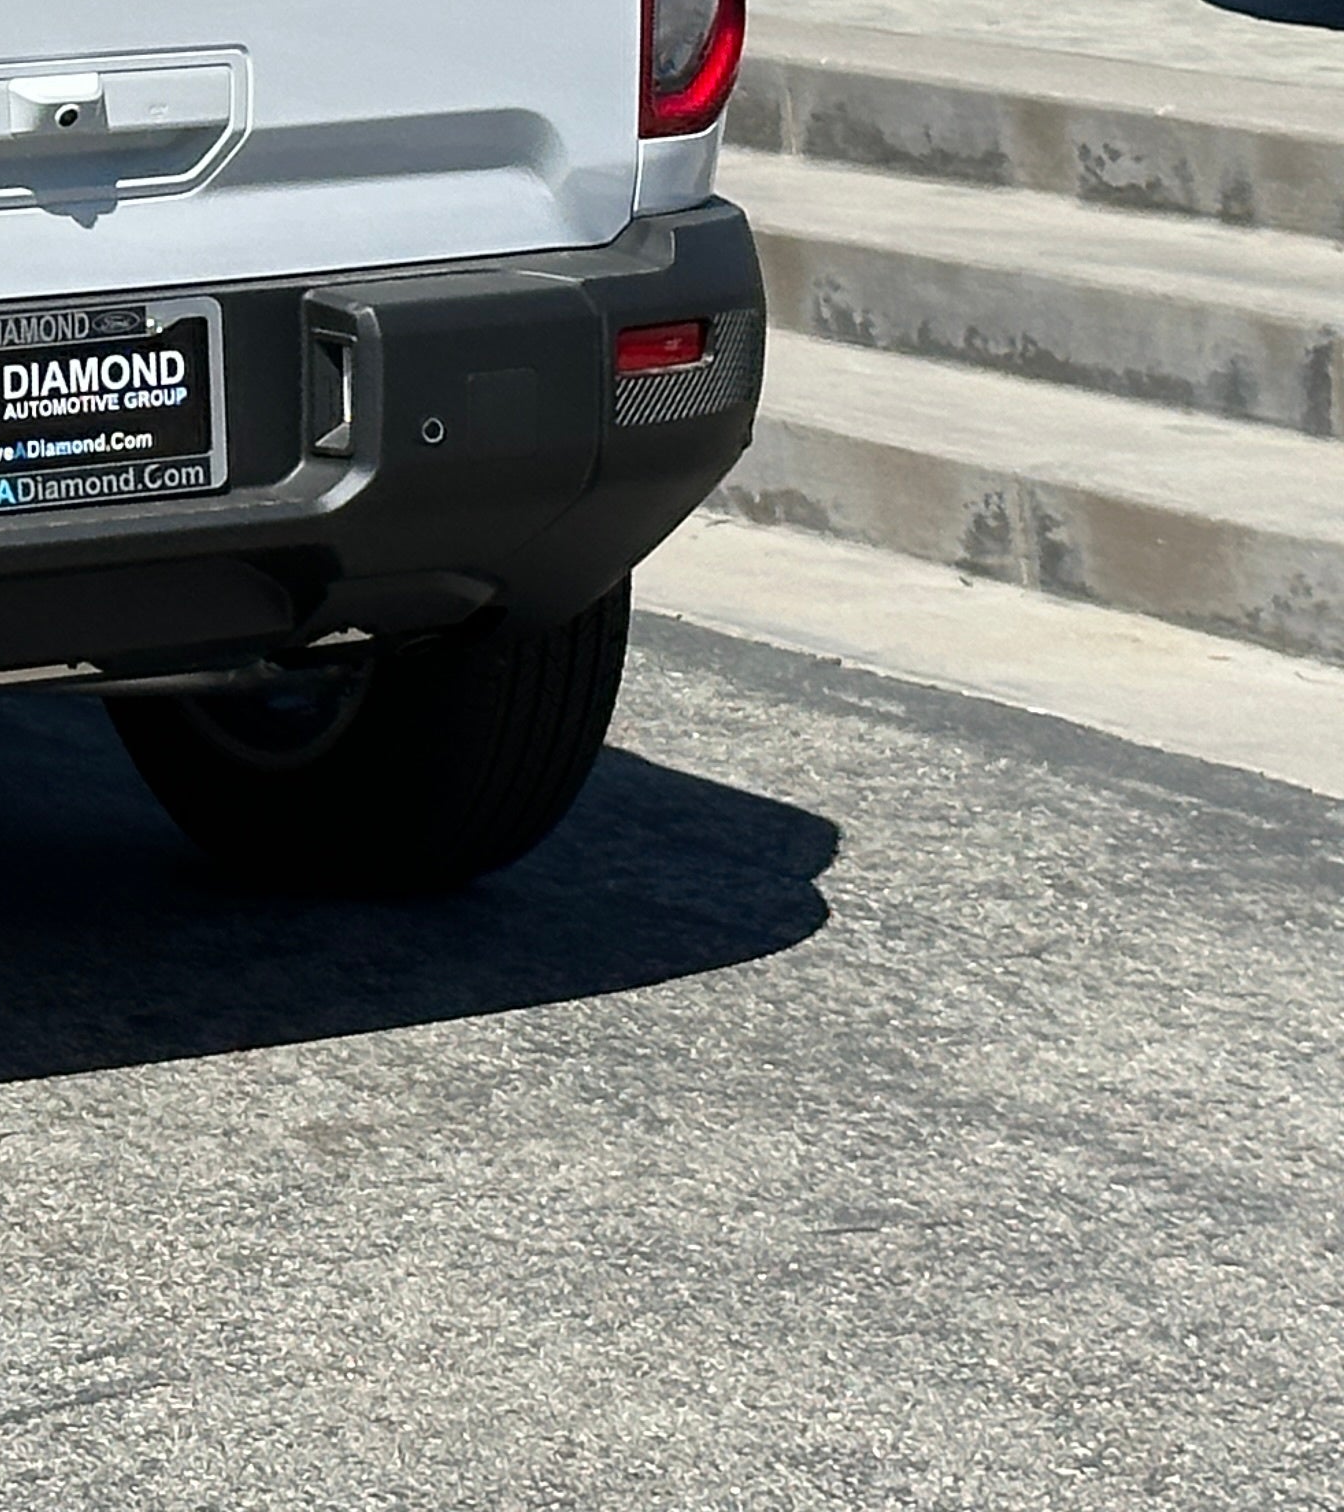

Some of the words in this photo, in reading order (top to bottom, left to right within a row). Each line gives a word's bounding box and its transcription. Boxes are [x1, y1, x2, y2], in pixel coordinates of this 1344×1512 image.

[3, 351, 185, 399] DIAMOND
[3, 393, 120, 421] AUTOMOTIVE
[123, 387, 188, 409] GROUP
